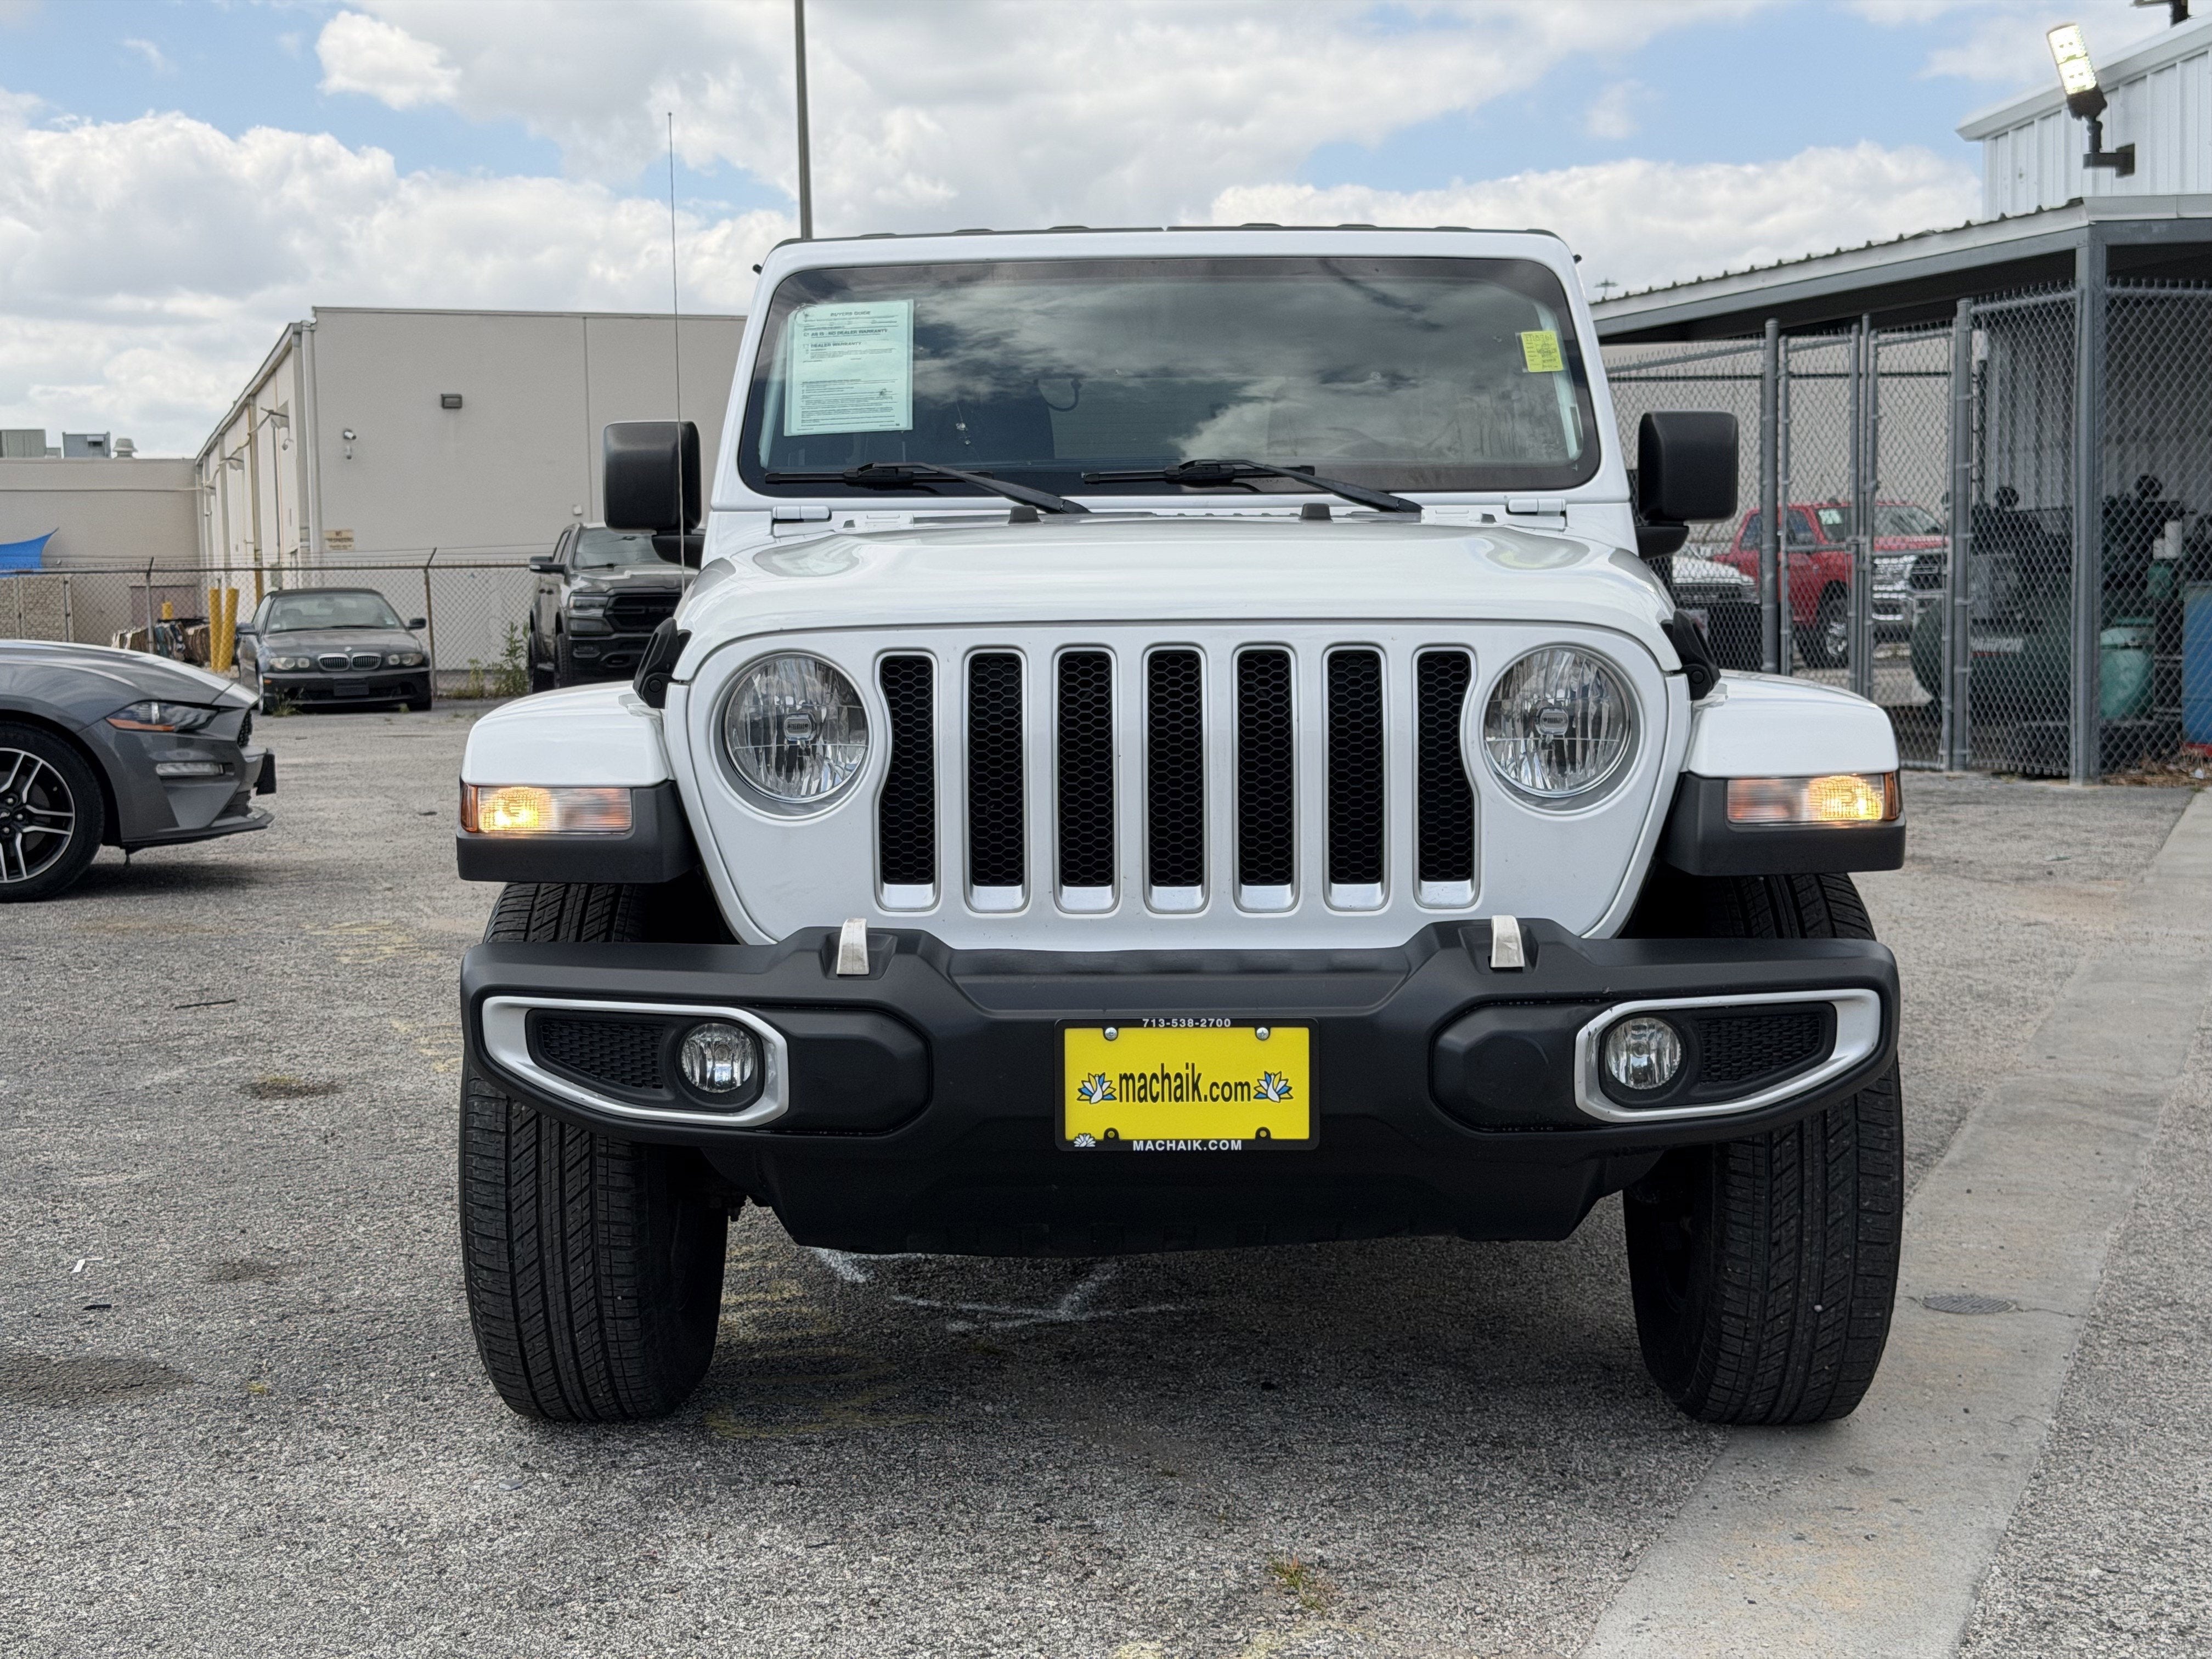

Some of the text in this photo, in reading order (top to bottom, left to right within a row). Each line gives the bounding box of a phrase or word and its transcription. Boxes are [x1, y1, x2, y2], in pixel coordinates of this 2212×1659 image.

[1142, 1018, 1231, 1028] 713-538-2700
[1118, 1062, 1251, 1104] machaik.com
[1132, 1139, 1243, 1152] MACHAIK.COM
